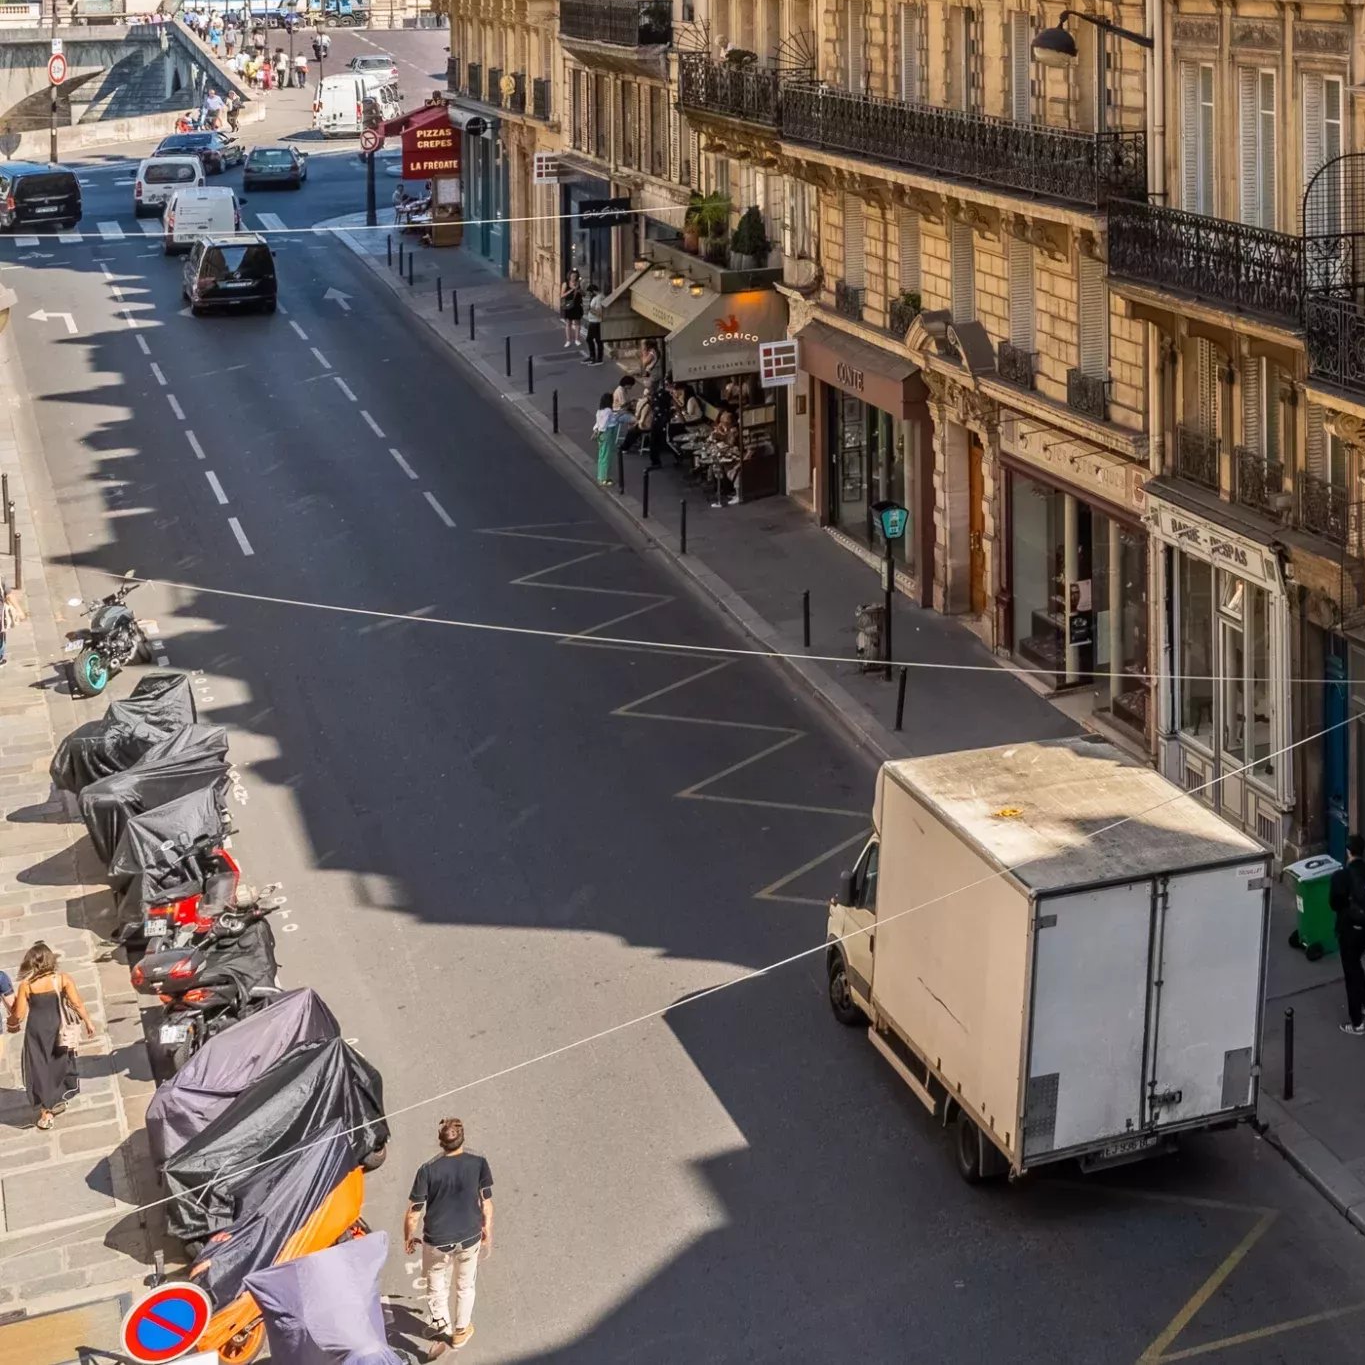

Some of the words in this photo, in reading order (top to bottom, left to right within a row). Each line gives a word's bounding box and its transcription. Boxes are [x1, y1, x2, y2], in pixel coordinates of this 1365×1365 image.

[416, 128, 453, 138] PIZZAS
[410, 162, 422, 171] LA
[702, 332, 759, 347] COCORICO
